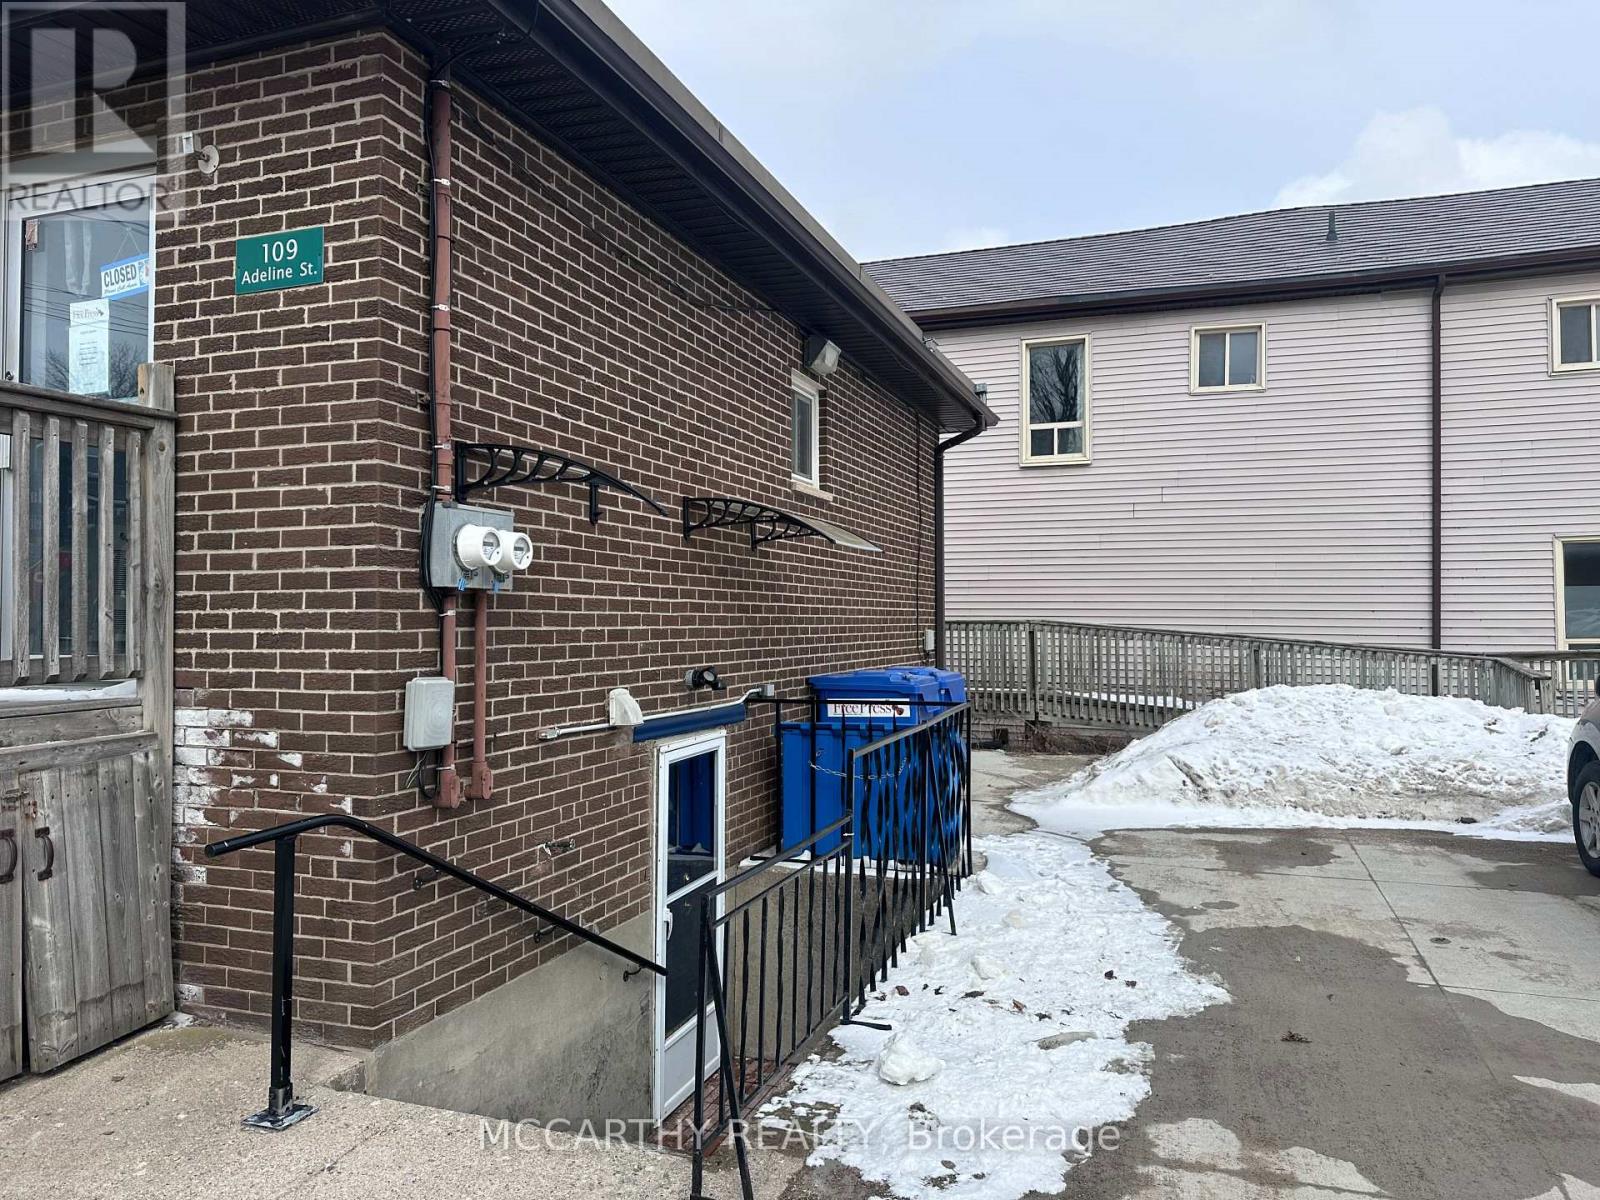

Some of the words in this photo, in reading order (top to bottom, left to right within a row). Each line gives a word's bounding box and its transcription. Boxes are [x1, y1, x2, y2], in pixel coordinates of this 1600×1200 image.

[262, 239, 298, 263] 109
[104, 264, 137, 288] CLOSED
[241, 266, 293, 285] Adeline
[300, 261, 317, 277] St.
